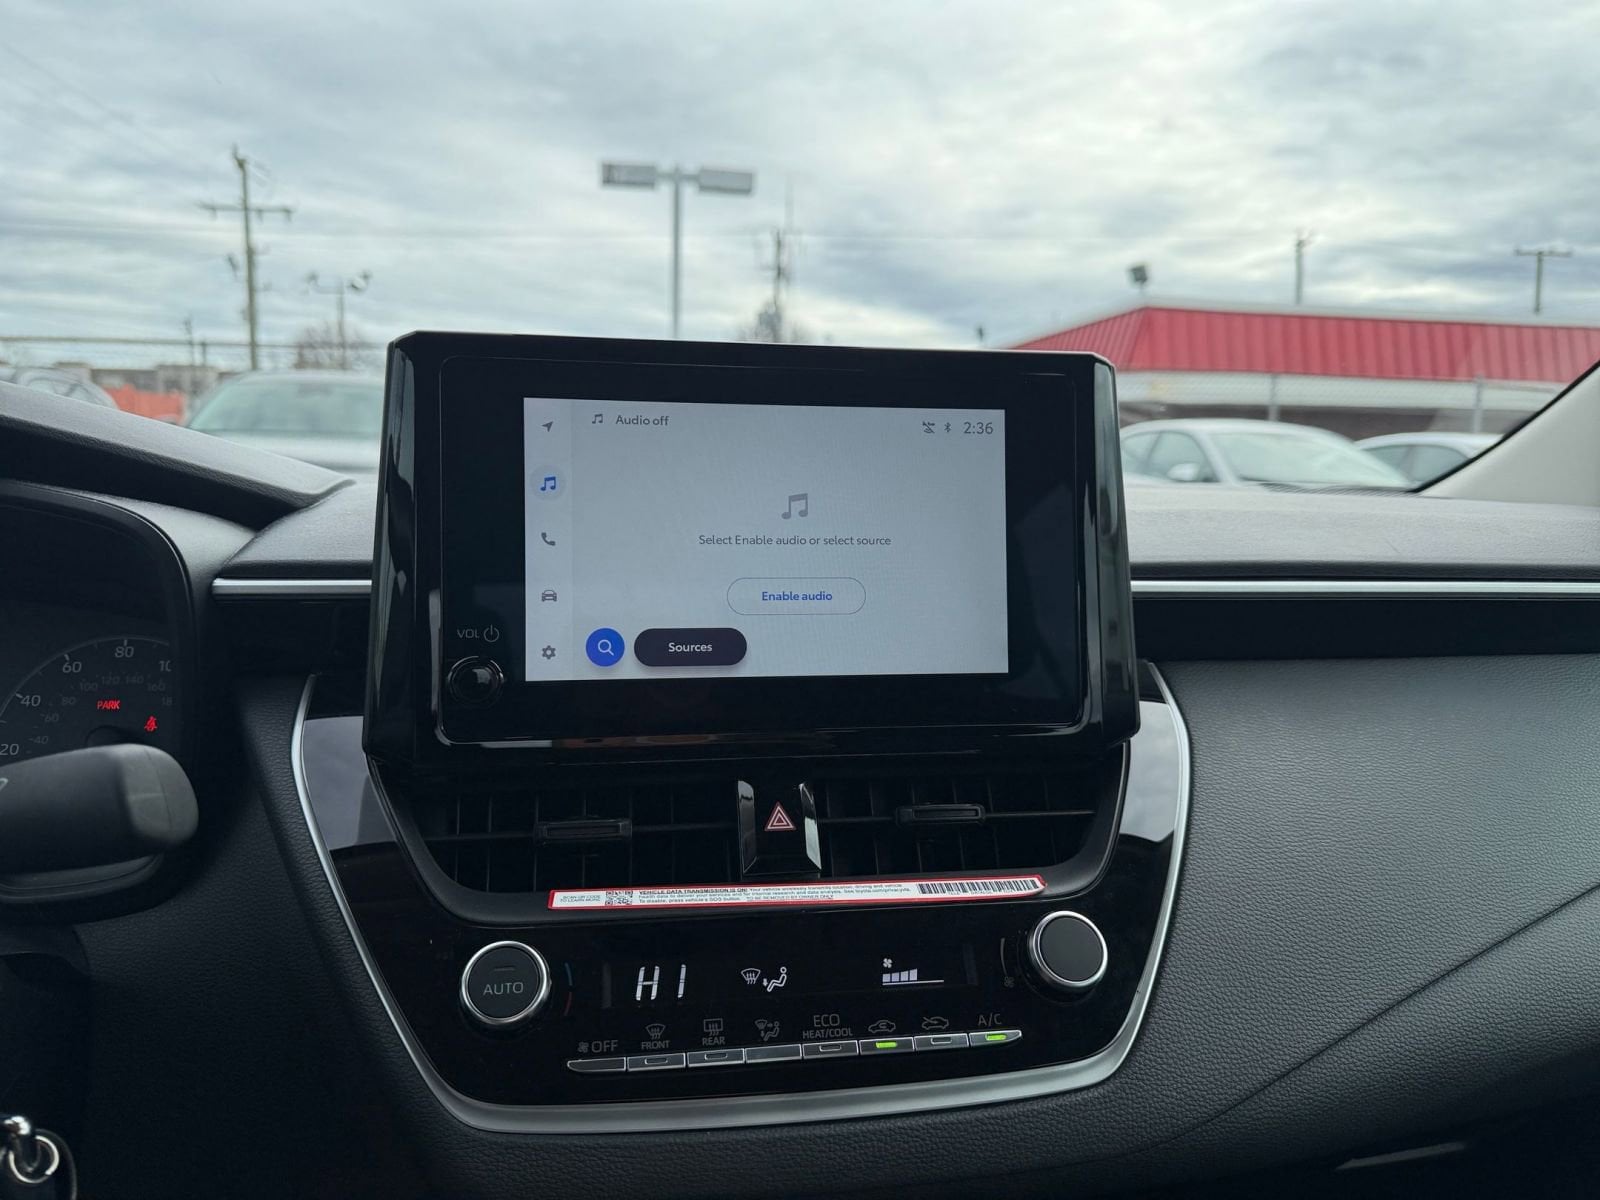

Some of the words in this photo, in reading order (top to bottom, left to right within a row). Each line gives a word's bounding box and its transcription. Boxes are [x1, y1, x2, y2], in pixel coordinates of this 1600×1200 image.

[615, 415, 650, 426] Audio
[652, 415, 670, 426] off
[963, 421, 994, 435] 2:36
[698, 534, 732, 546] Select
[735, 534, 774, 546] Enable
[776, 534, 806, 546] audio
[809, 537, 820, 546] or
[823, 534, 854, 546] select
[856, 537, 892, 546] source
[761, 591, 800, 602] Enable
[802, 591, 833, 602] audio
[456, 628, 480, 640] VOL
[114, 646, 134, 658] 80
[668, 642, 713, 653] Sources
[62, 661, 82, 674] 60
[21, 695, 40, 707] 40
[96, 699, 121, 710] PARK
[0, 744, 20, 756] 20
[482, 982, 524, 996] AUTO
[814, 1014, 840, 1027] ECO
[978, 1013, 1002, 1027] A/C
[802, 1028, 853, 1040] HEAT/COOL
[591, 1040, 618, 1052] OFF
[640, 1040, 670, 1050] FRONT
[702, 1036, 726, 1046] REAR
